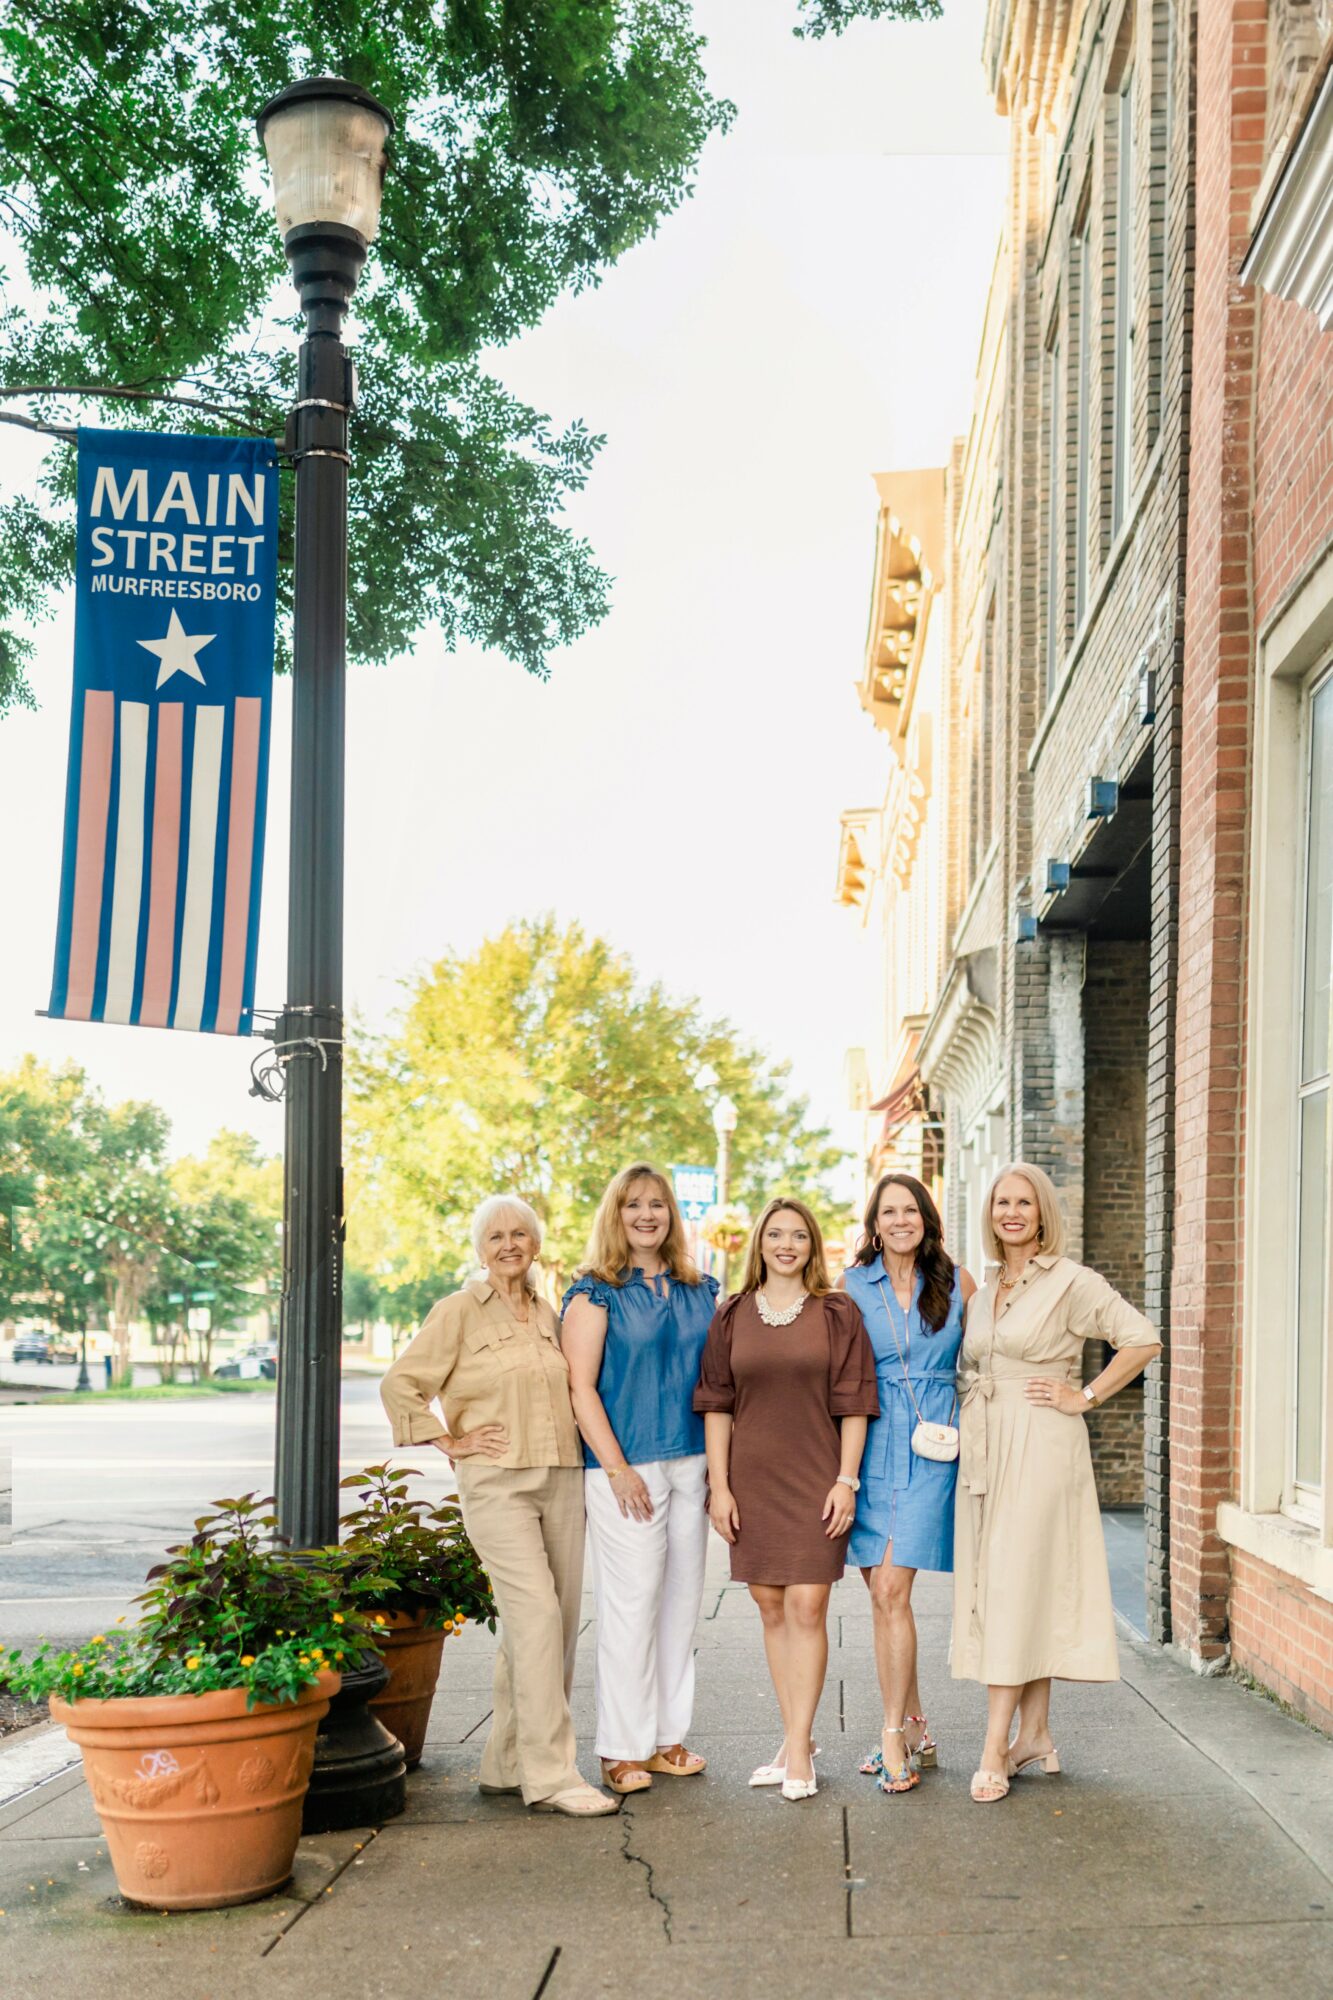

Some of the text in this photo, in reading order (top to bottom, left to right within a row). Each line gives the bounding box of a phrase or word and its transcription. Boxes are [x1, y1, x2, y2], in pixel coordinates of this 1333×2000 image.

[90, 466, 265, 527] MAIN
[91, 526, 265, 576] STREET
[91, 574, 261, 602] MURFREESBORO
